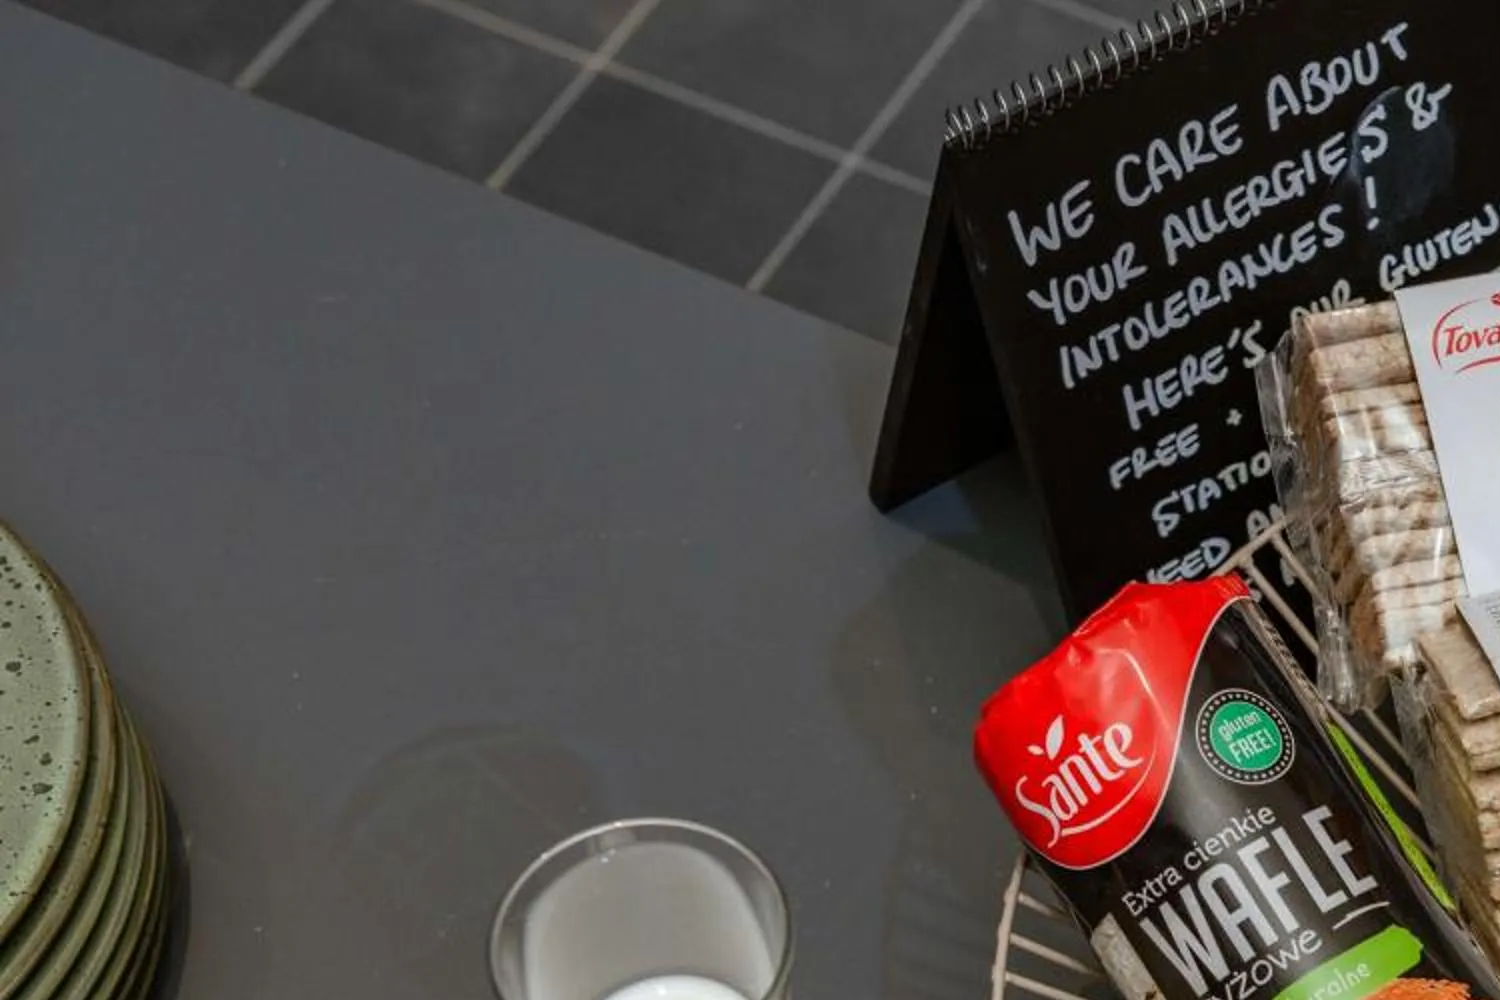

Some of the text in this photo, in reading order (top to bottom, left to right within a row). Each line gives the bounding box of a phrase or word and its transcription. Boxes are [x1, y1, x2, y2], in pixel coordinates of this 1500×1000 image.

[1008, 22, 1409, 267] WE CARE ABOUT
[1027, 82, 1452, 325] YOUR ALLERGIES &
[1058, 204, 1345, 388] INTOLERANCES
[1121, 320, 1267, 430] HERE'S
[1108, 423, 1200, 490] FREE
[1151, 450, 1273, 538] STATIO
[1218, 711, 1261, 742] gluten
[1228, 728, 1277, 763] FREE!
[1015, 721, 1144, 848] Sante
[1121, 806, 1277, 917] Extra cienkie
[1140, 805, 1378, 998] WAFLE
